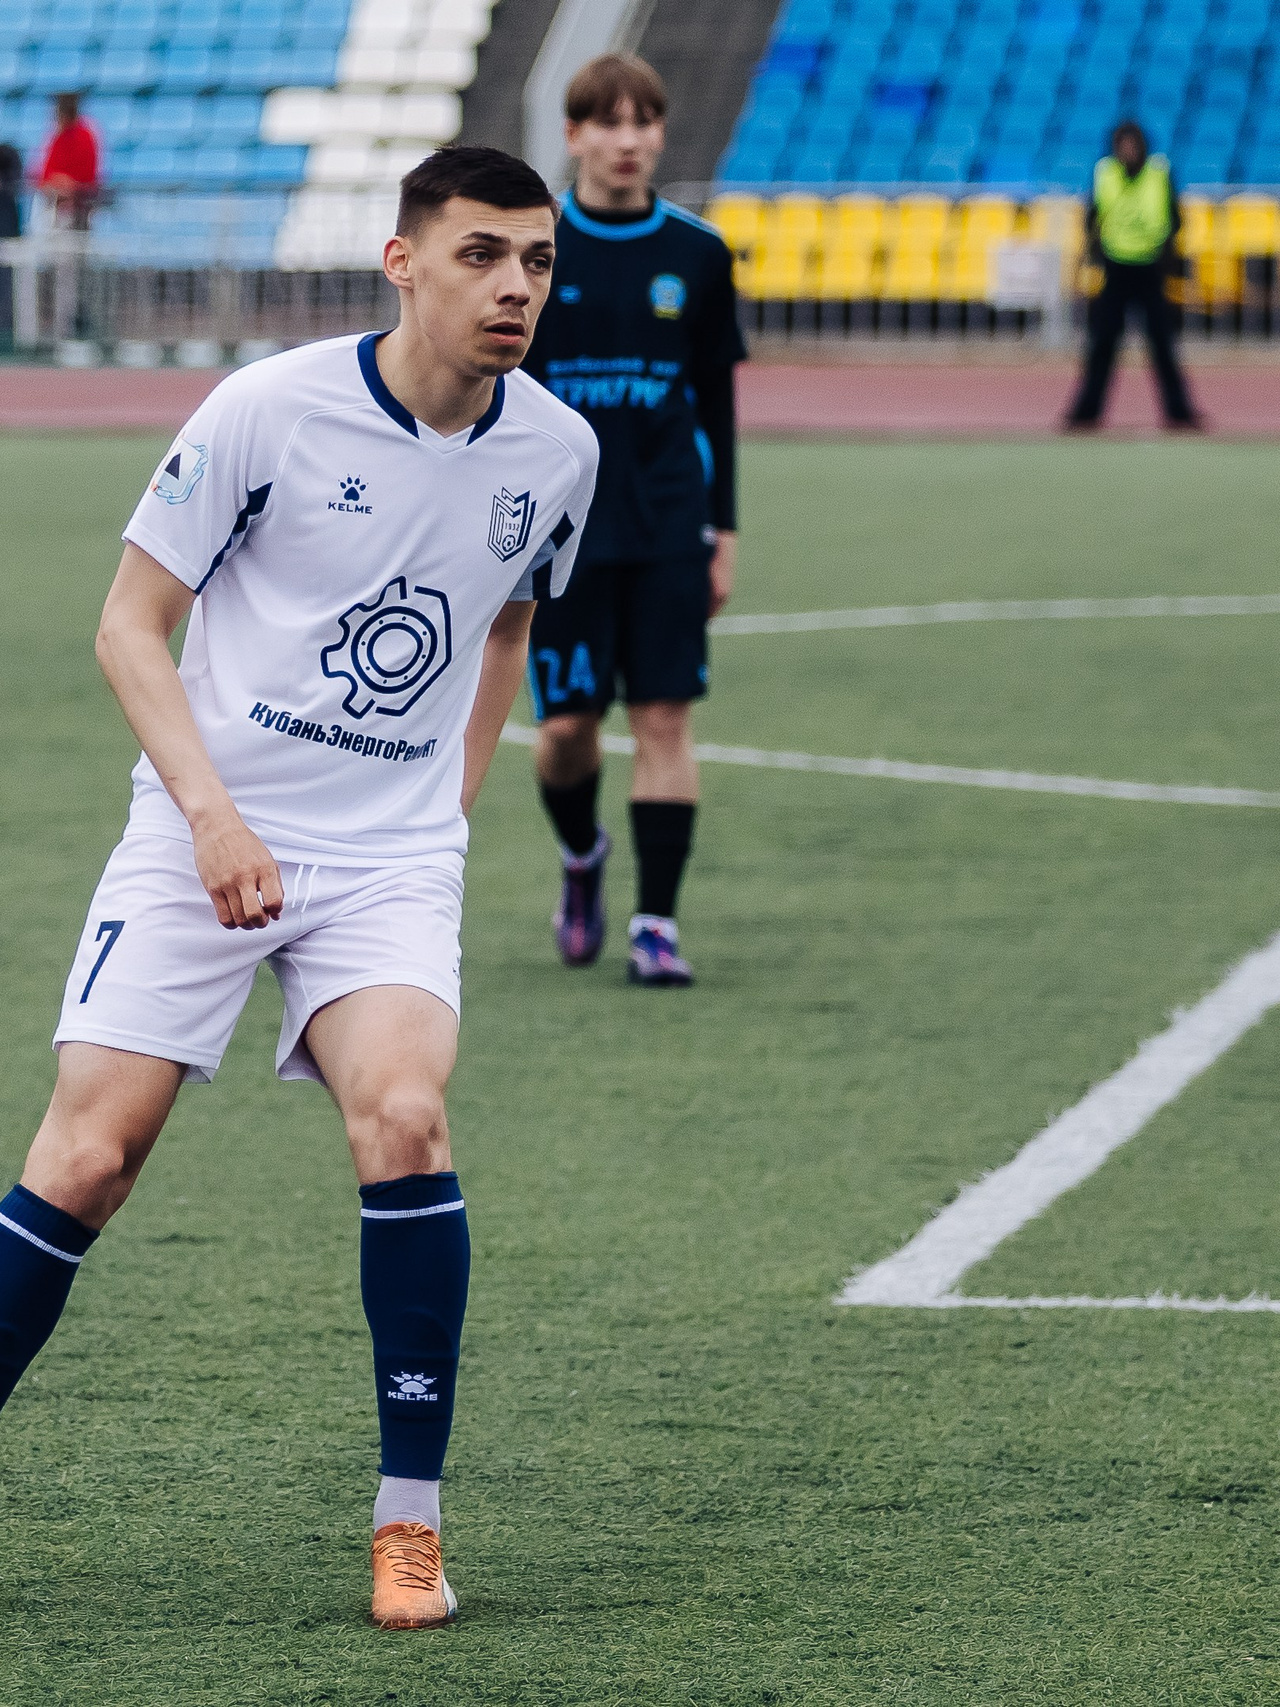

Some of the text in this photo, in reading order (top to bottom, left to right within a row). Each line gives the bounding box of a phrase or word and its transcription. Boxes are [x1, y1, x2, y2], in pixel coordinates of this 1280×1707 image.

[327, 501, 373, 515] KELME
[537, 638, 596, 703] 24
[79, 920, 126, 1004] 7
[387, 1390, 438, 1401] KELME
